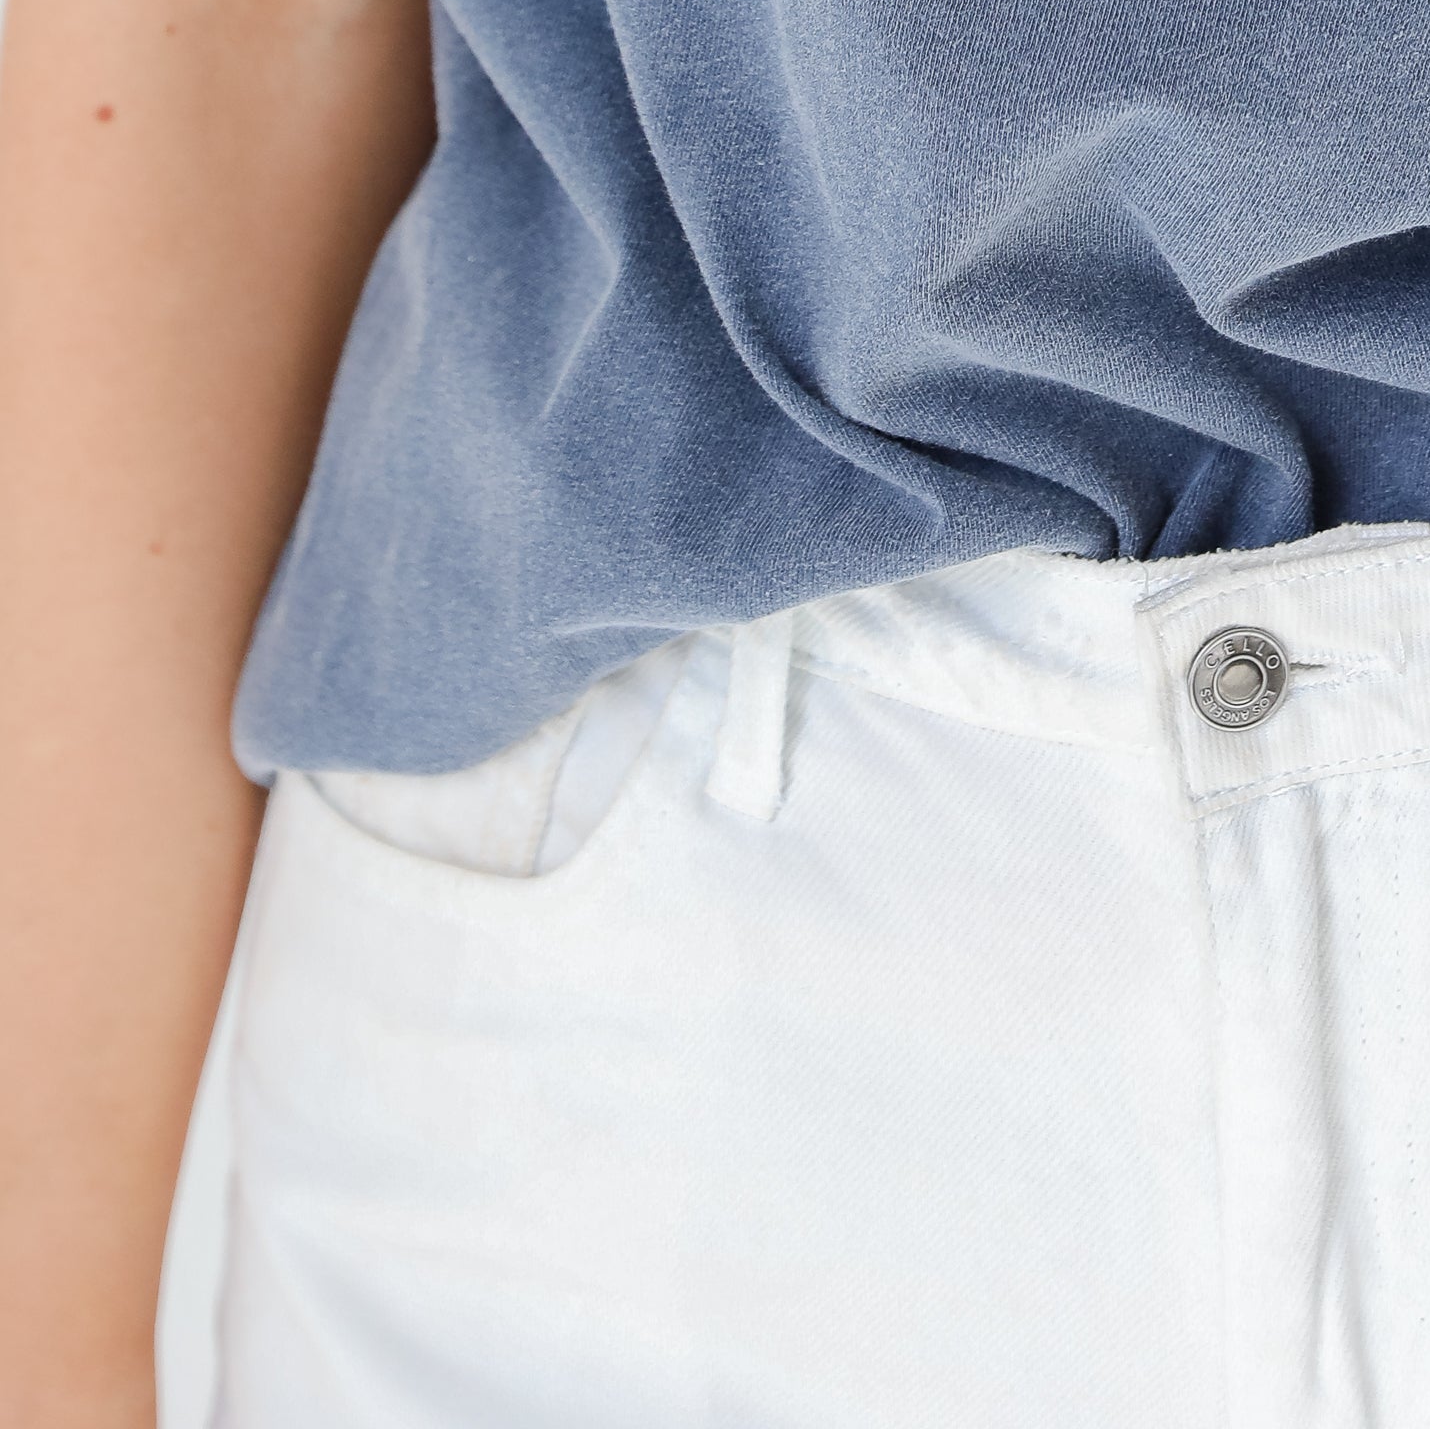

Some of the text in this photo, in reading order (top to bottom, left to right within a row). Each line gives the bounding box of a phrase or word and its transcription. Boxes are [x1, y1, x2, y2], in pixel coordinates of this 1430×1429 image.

[1205, 637, 1280, 669] CELLO
[1200, 688, 1276, 722] LOS ANGELES
